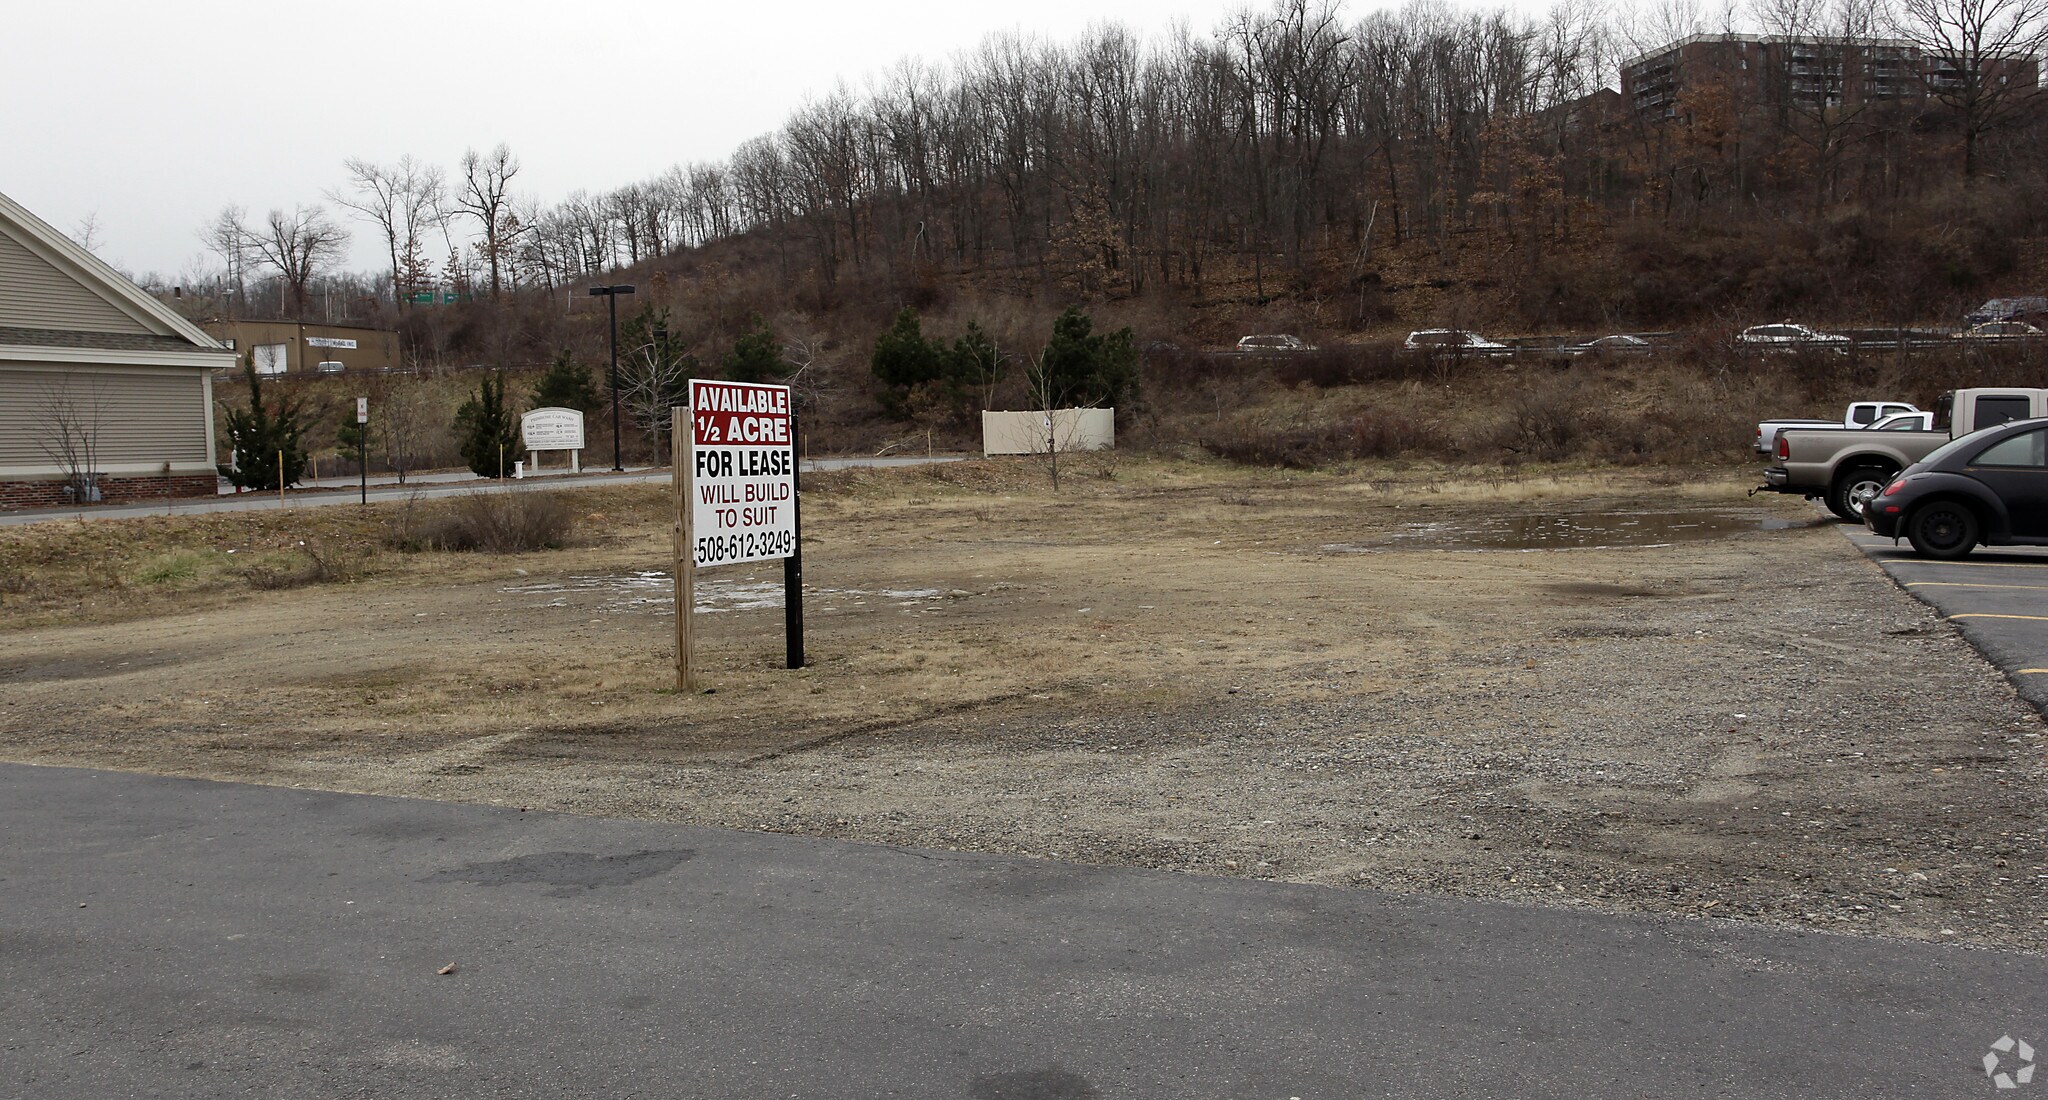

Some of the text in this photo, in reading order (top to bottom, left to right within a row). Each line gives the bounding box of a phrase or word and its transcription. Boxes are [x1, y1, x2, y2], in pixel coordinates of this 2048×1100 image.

[698, 386, 787, 414] AVAILABLE
[727, 416, 788, 442] ACRE
[696, 450, 791, 478] FOR LEASE
[700, 483, 789, 505] WILL BUILD
[715, 506, 777, 528] TO SUIT
[698, 530, 791, 563] 508-612-3249
